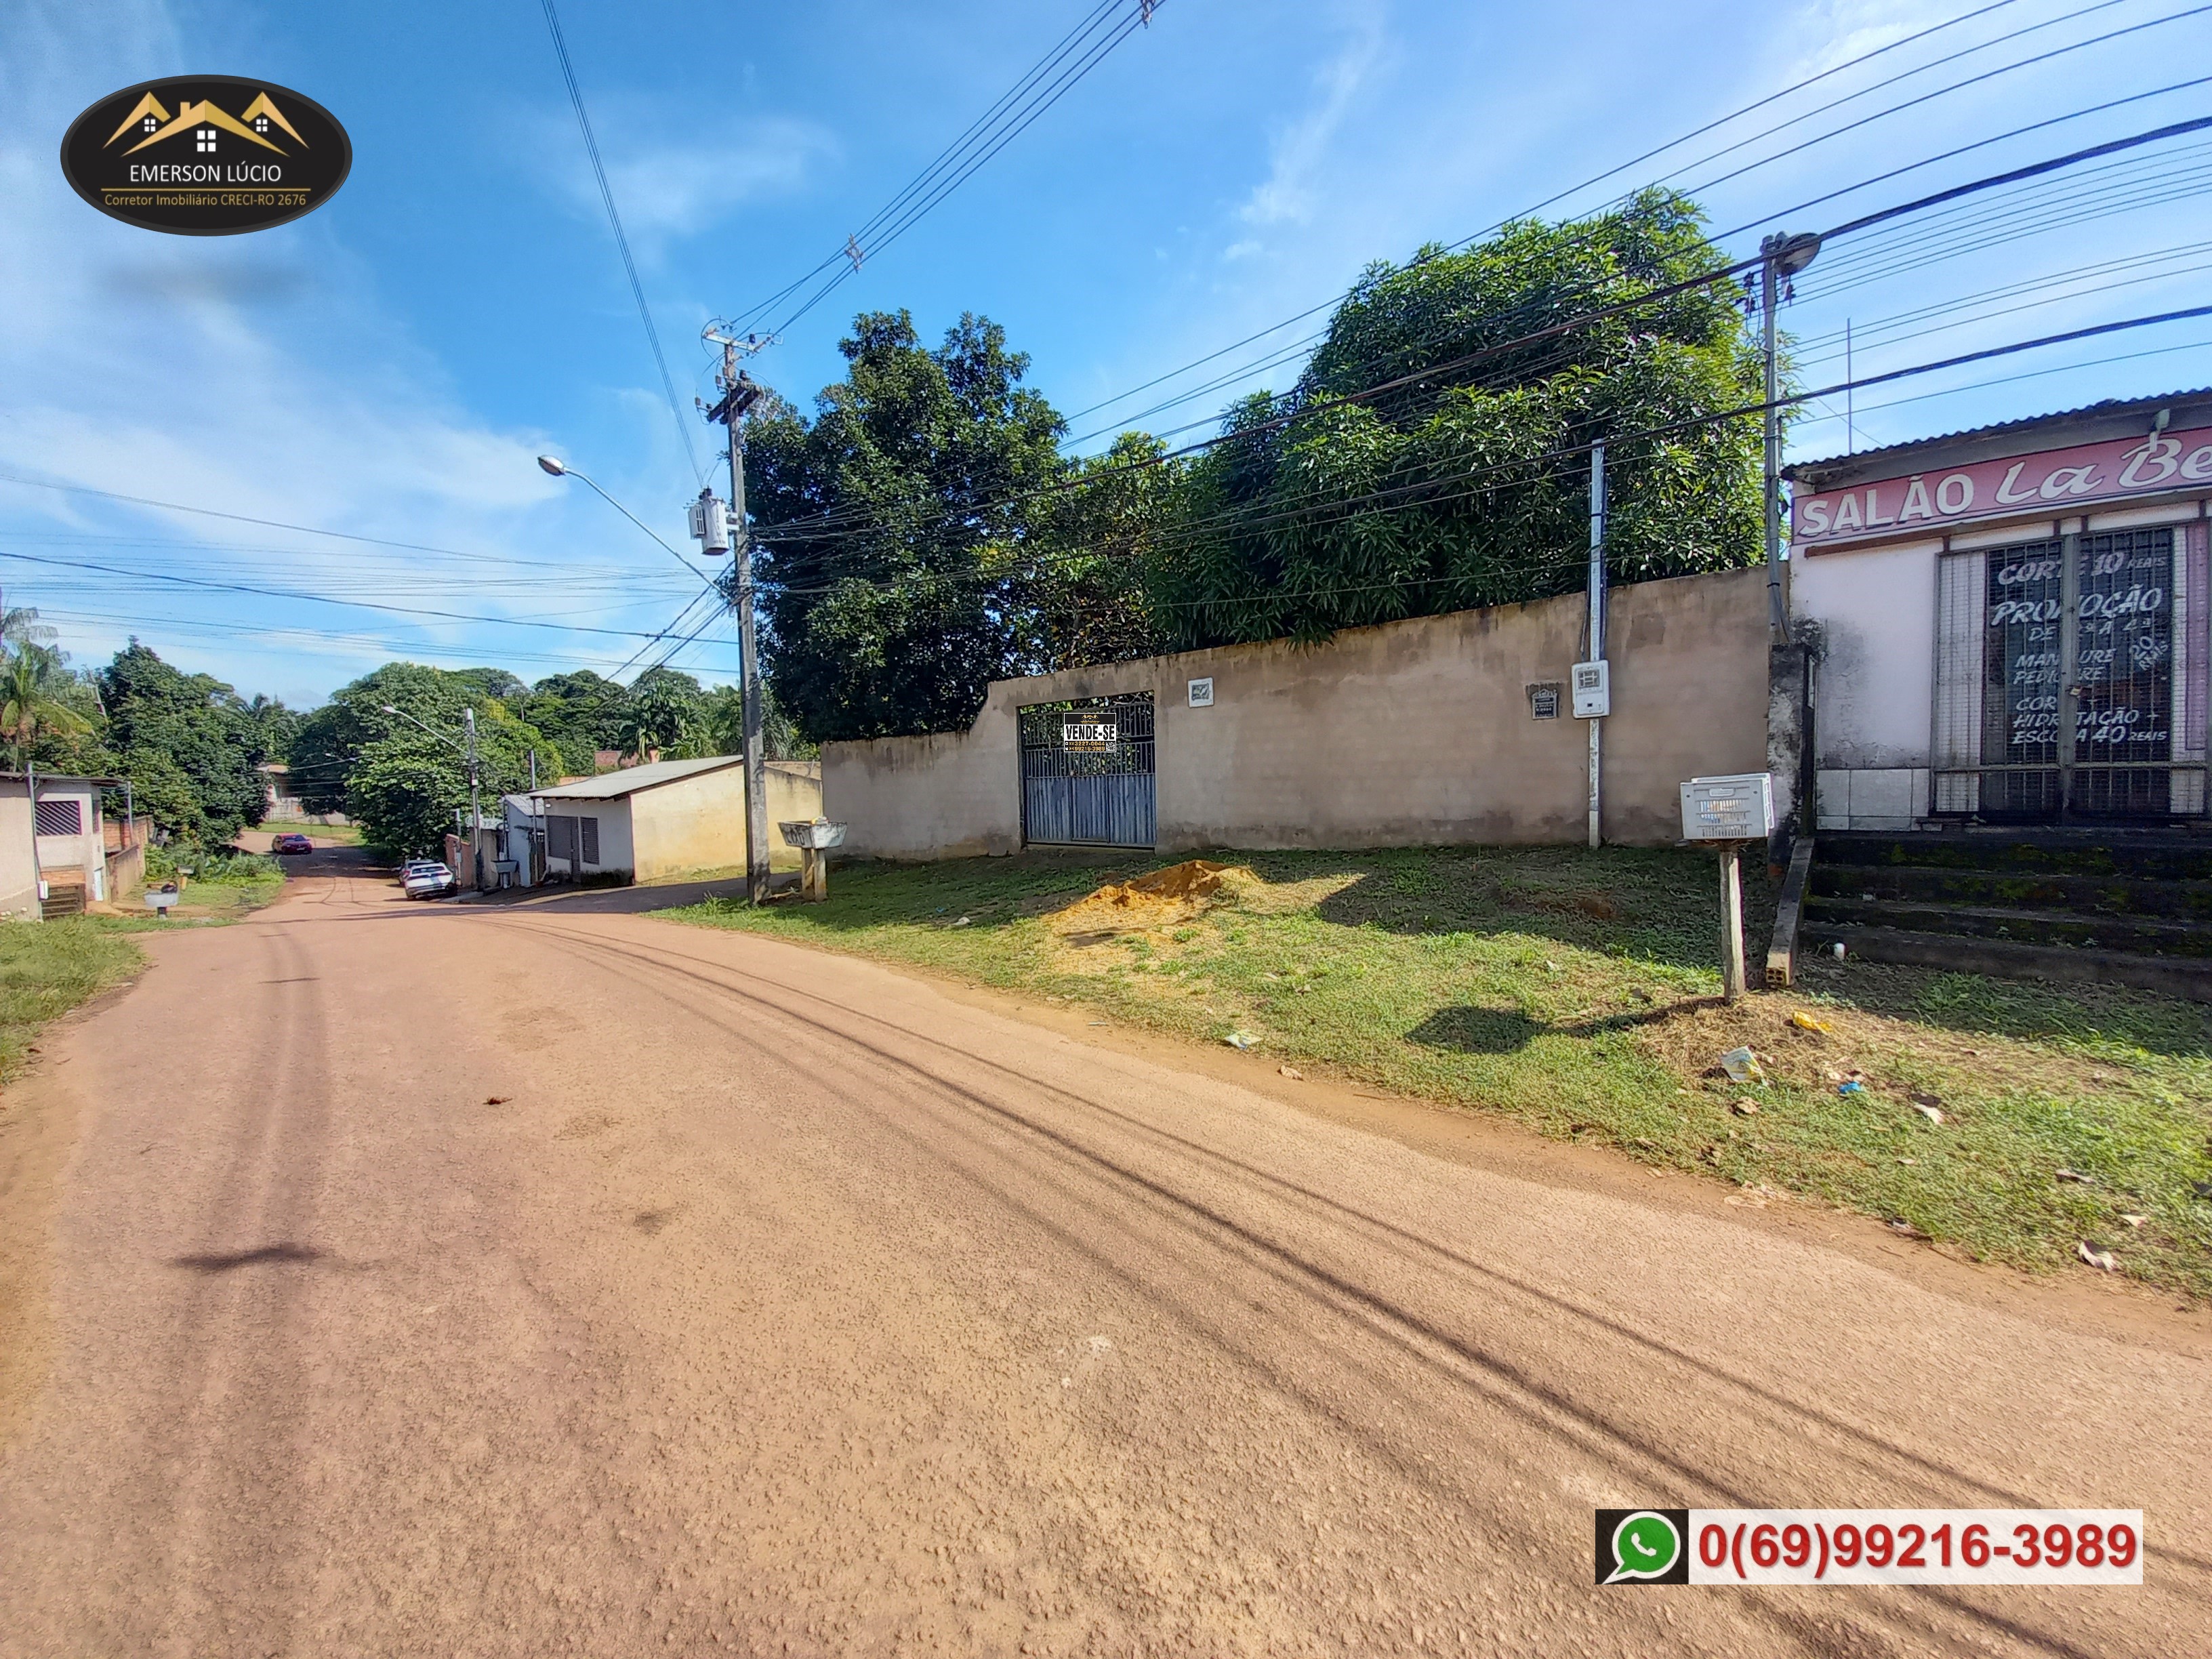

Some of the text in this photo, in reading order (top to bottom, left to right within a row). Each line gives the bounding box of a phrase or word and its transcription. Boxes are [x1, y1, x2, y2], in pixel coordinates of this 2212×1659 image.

[1798, 474, 1975, 537] SALÃO
[1994, 461, 2104, 505] La
[2091, 551, 2125, 577] 10
[2028, 626, 2057, 641] DE
[2098, 621, 2114, 635] A
[2014, 648, 2117, 668] MANURE
[2011, 707, 2139, 729] HIDRTAÇÃO
[2011, 725, 2169, 744] ESCOA 40 REAIS
